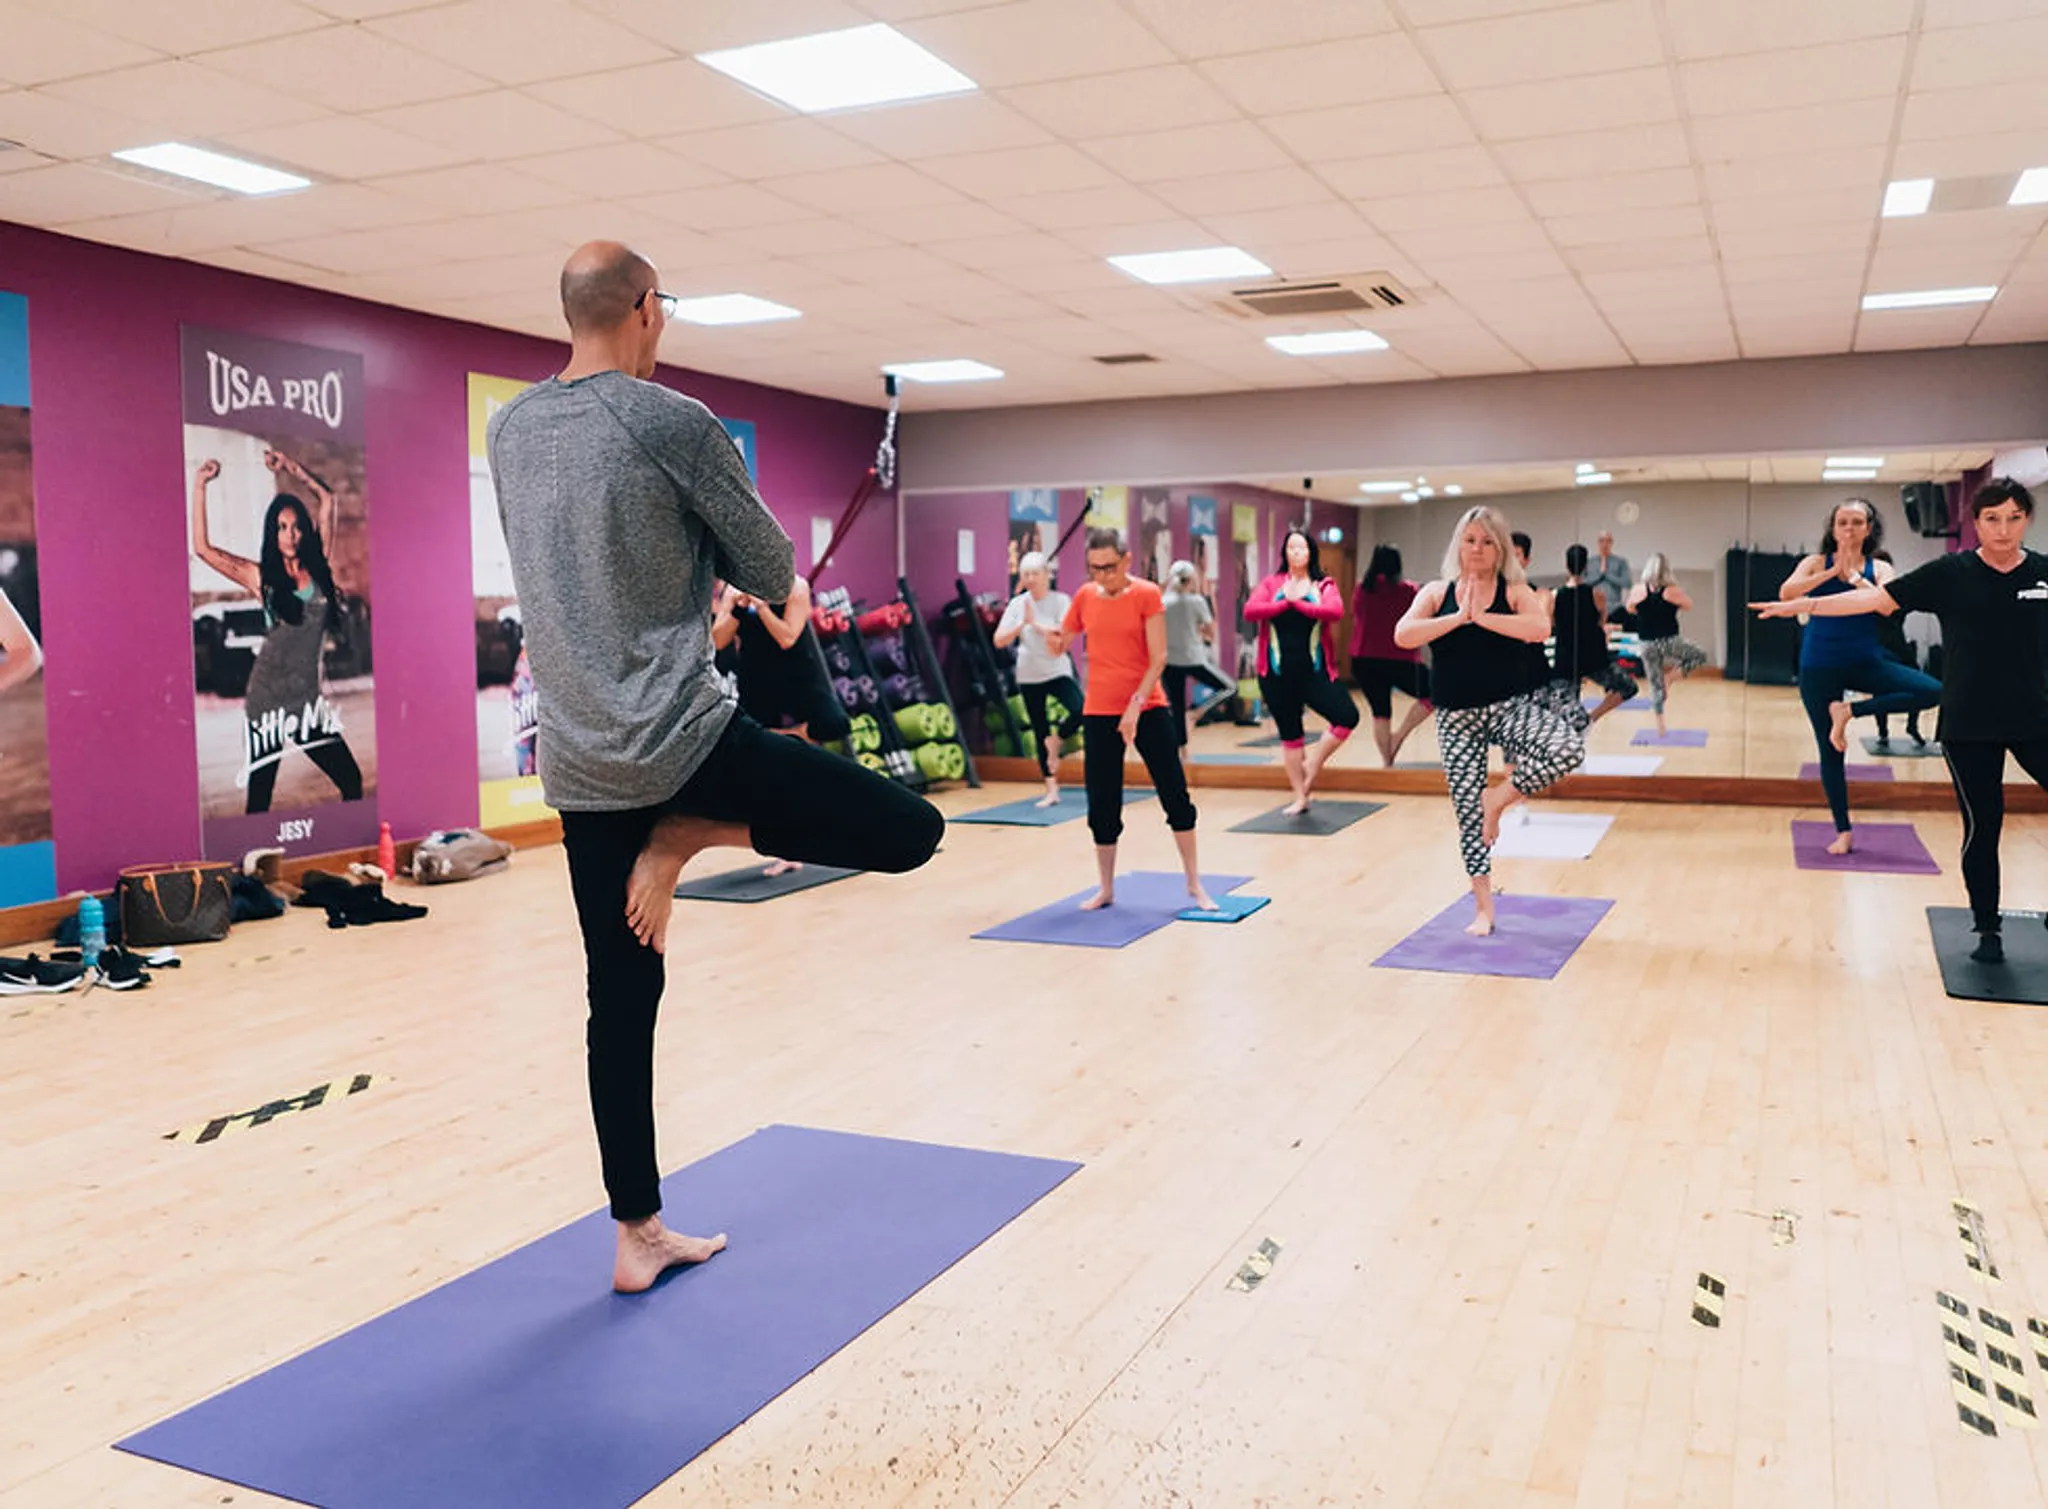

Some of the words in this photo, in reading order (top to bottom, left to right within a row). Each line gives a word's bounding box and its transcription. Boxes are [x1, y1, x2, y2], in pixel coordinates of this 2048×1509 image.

[206, 350, 275, 415] USA
[282, 371, 342, 428] PRO
[235, 706, 299, 789] Little
[300, 695, 344, 742] Mix
[276, 818, 314, 843] JESY
